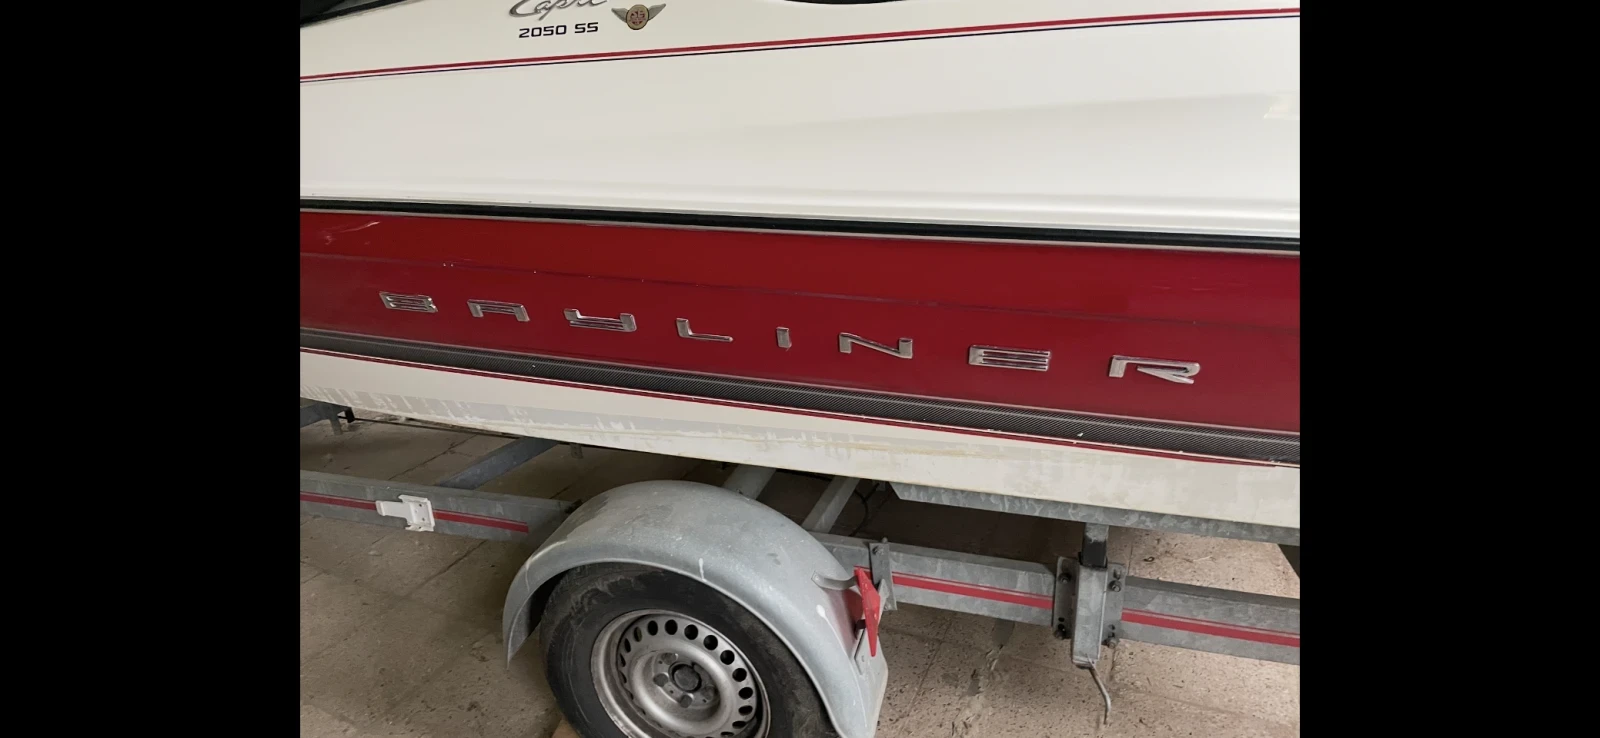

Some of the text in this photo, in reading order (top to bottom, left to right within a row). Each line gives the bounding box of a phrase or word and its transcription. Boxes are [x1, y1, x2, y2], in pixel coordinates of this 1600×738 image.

[518, 22, 599, 38] 2050 SS
[379, 291, 1201, 385] BAYLINER
